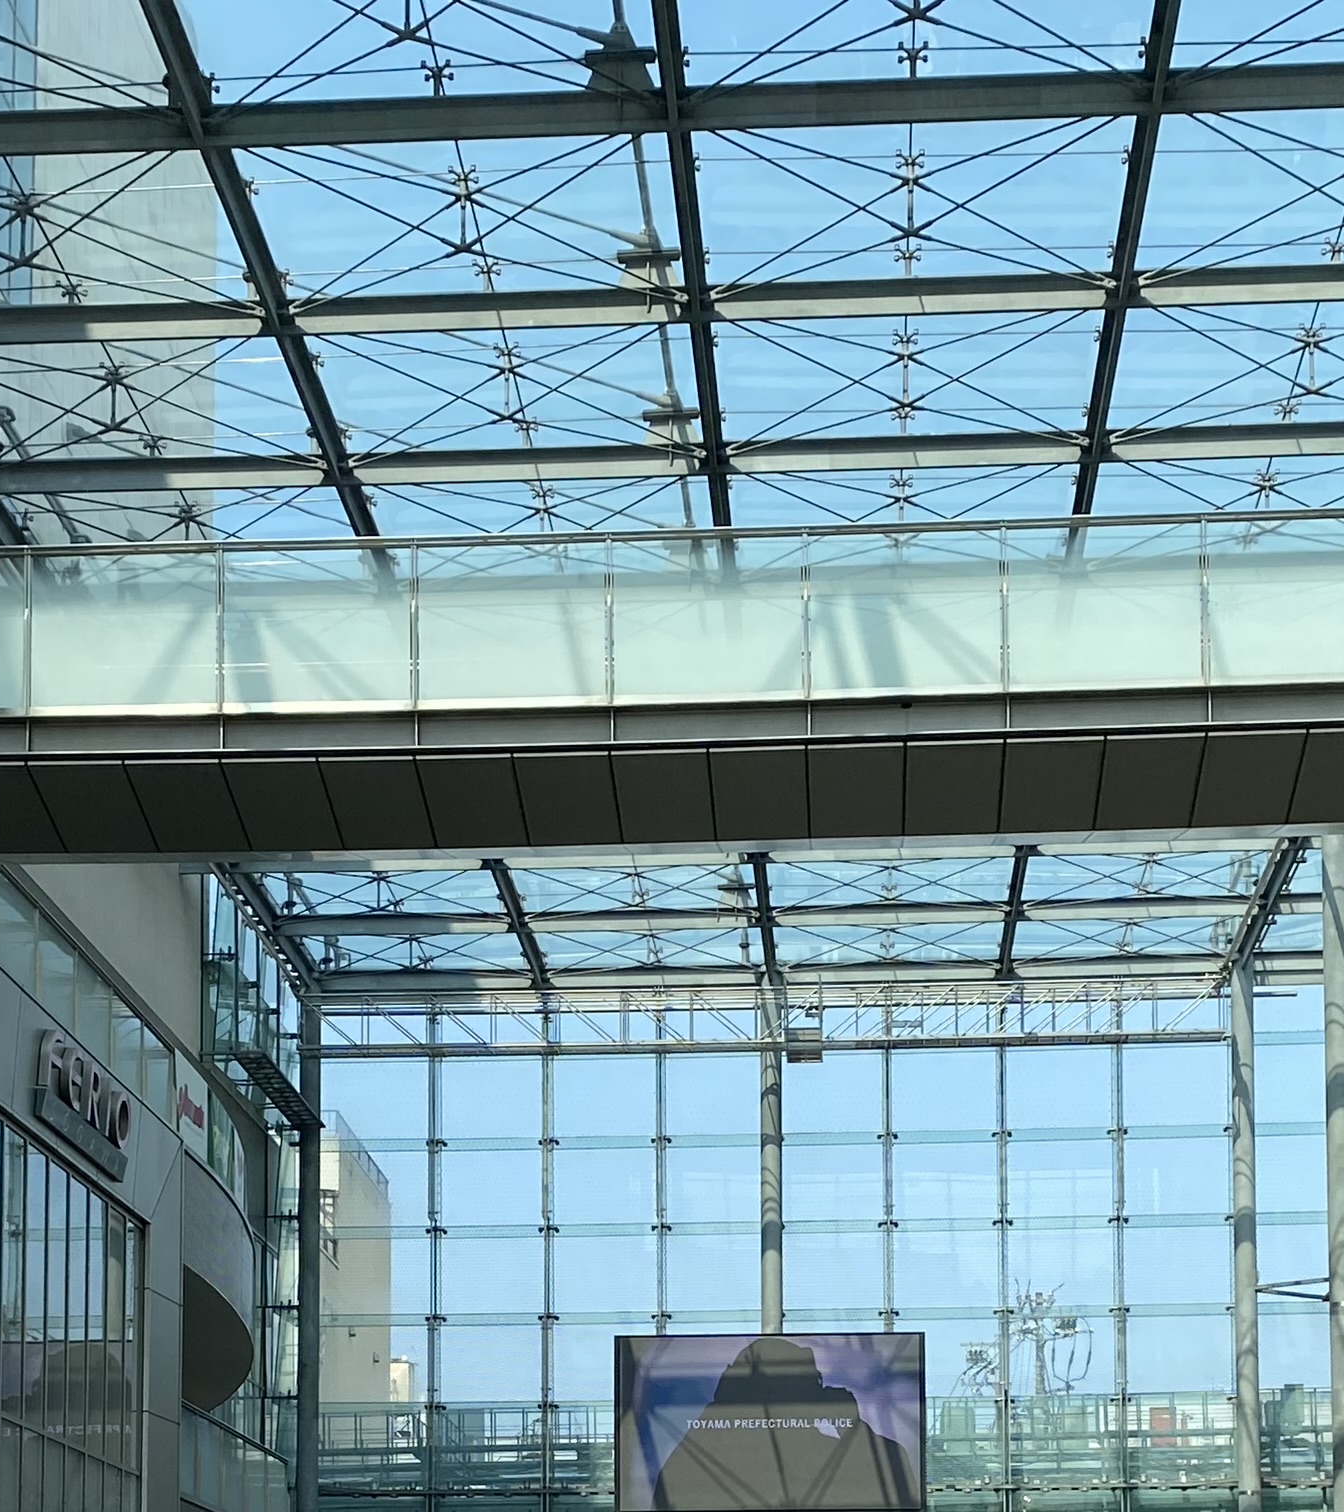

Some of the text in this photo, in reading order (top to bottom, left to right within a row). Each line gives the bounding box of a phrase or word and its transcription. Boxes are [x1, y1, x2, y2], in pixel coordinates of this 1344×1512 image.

[686, 1417, 853, 1429] TOYAMA PREFECTURAL POLICE
